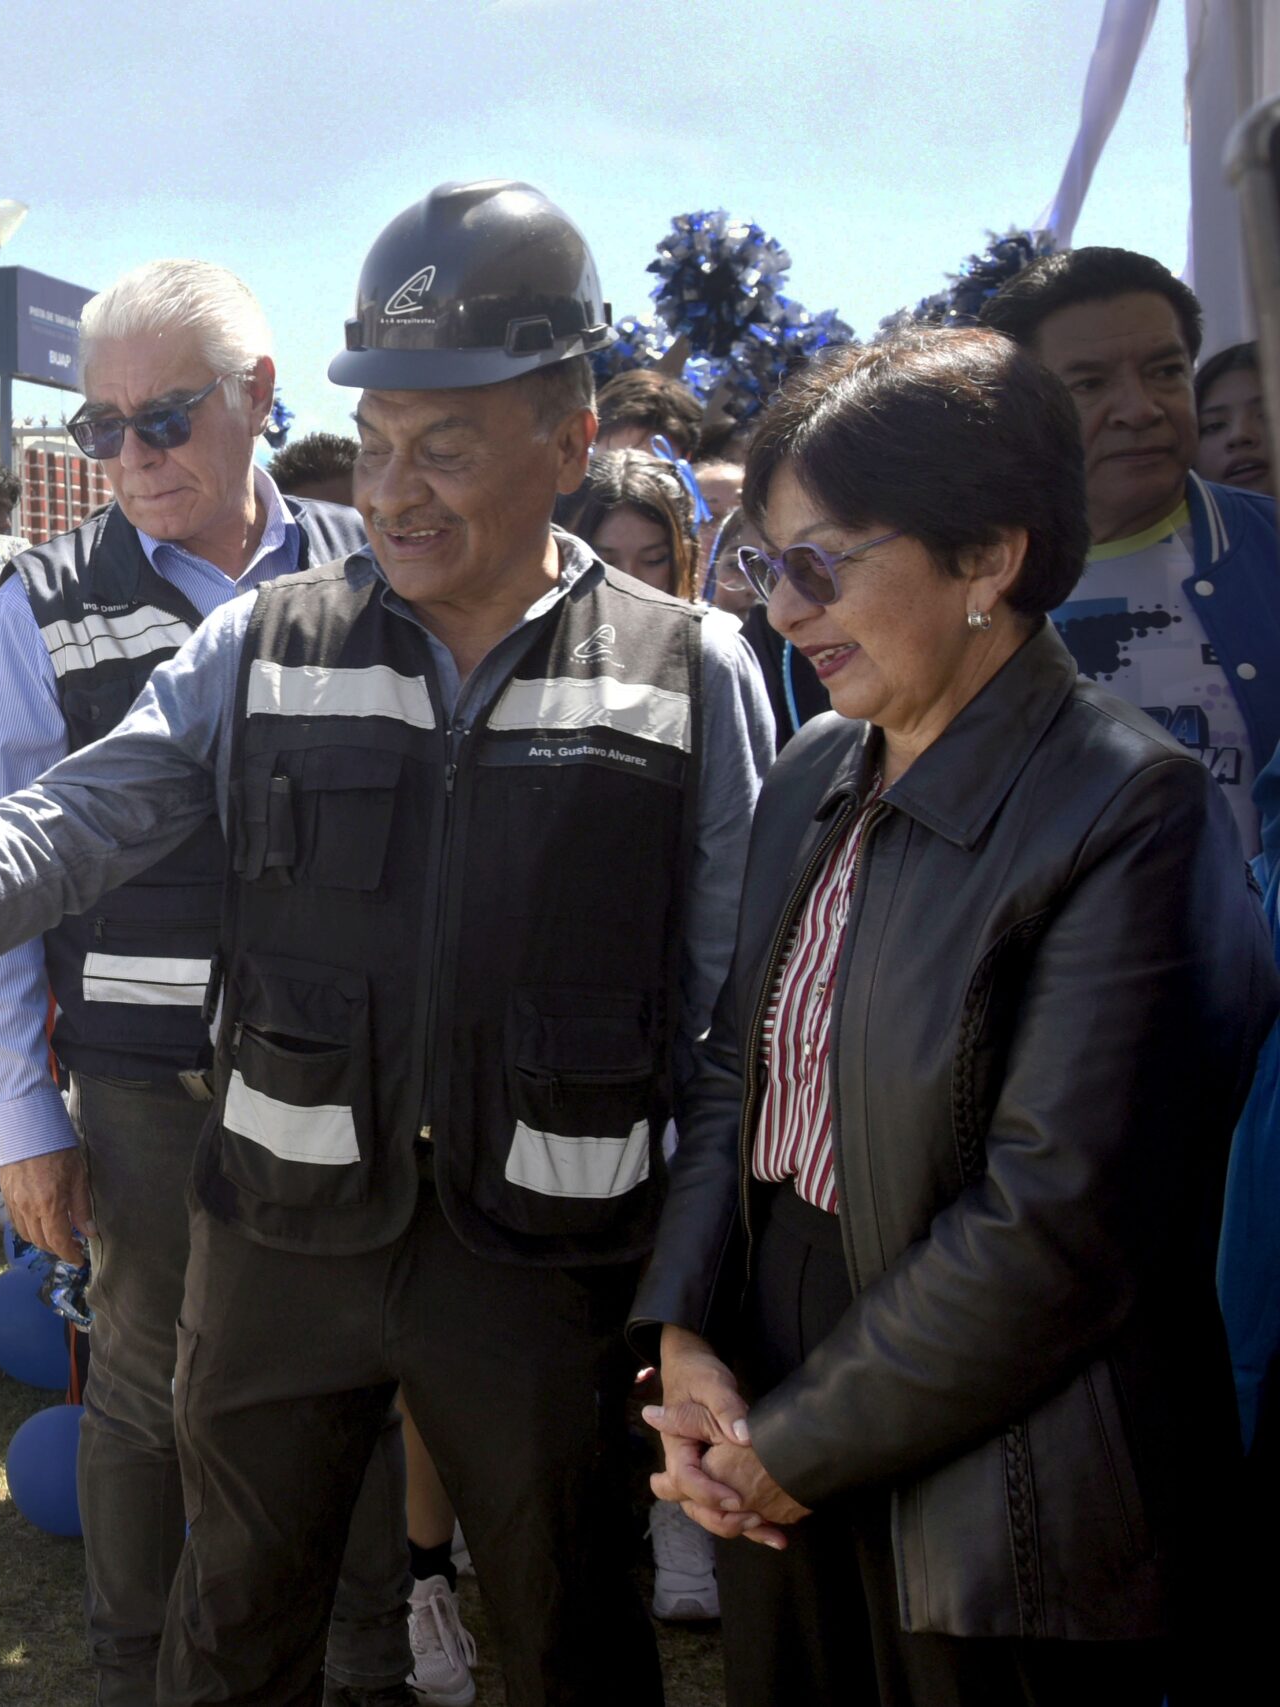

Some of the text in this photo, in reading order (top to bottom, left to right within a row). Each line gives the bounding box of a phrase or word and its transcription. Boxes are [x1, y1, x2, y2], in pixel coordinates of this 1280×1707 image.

[528, 745, 648, 767] Arq. Gustavo Alvarez
